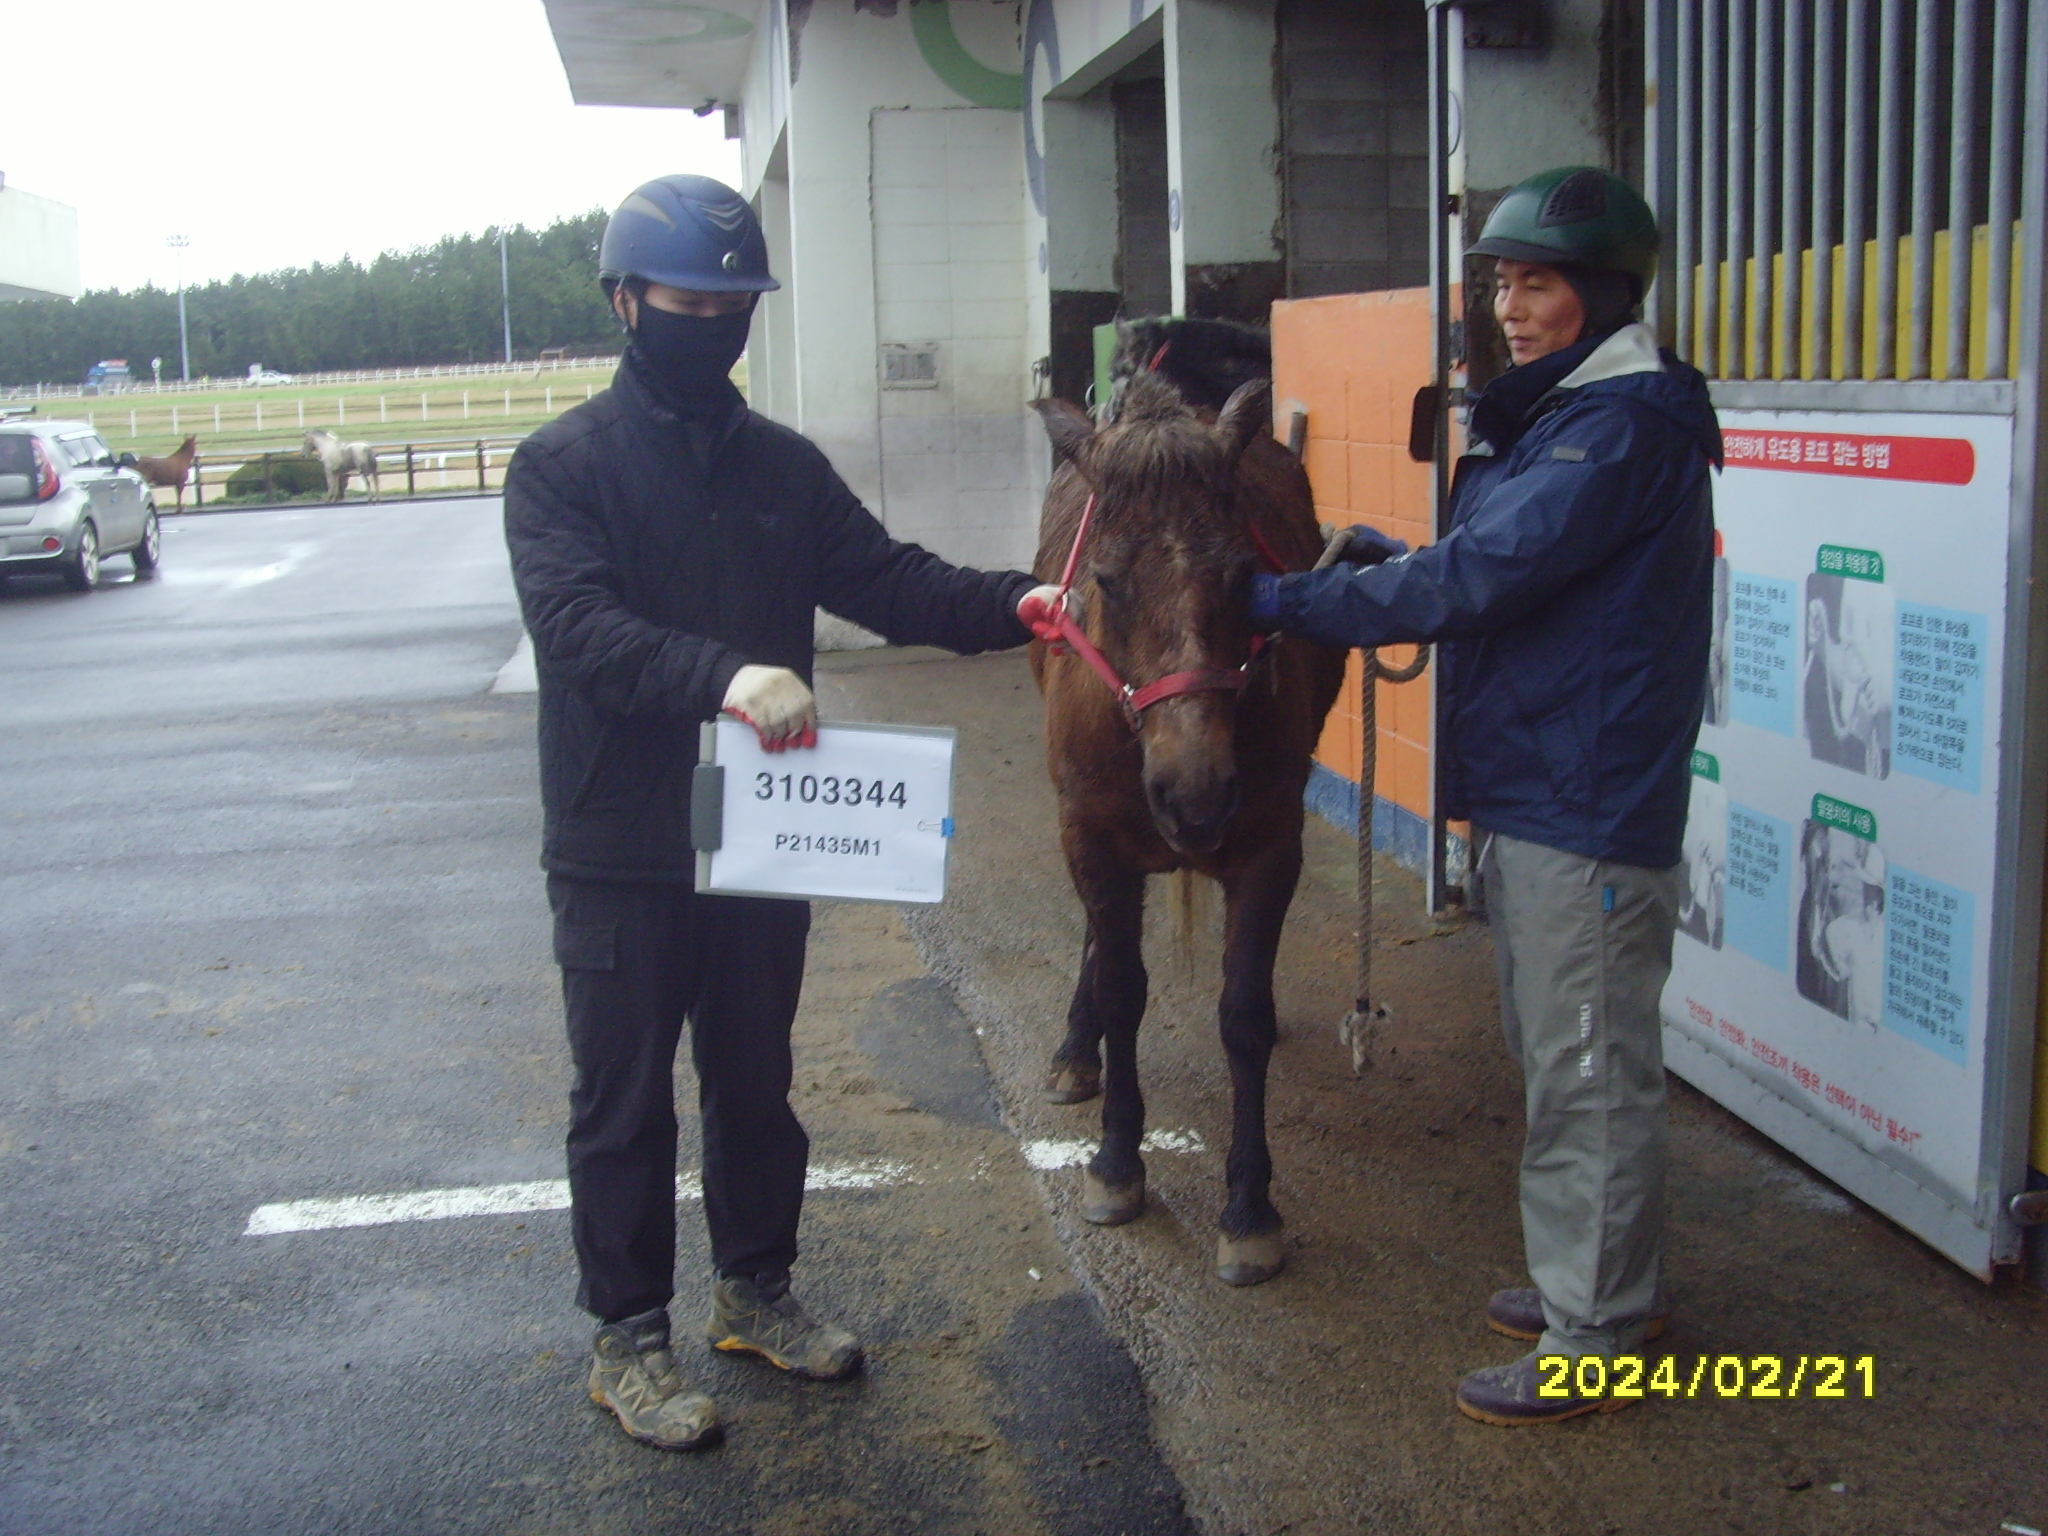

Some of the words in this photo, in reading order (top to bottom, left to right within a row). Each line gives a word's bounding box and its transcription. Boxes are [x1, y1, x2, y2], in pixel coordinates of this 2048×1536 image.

[1723, 435, 1765, 460] 안전하게
[1768, 436, 1801, 463] 유도용
[1804, 440, 1830, 462] 로프
[1833, 441, 1858, 467] 잡는
[1862, 442, 1890, 469] 방법
[1821, 549, 1844, 570] 장갑을
[1845, 553, 1870, 574] 착용할
[1870, 557, 1880, 575] 것
[755, 772, 908, 809] 3103344
[775, 833, 881, 857] P21435M1
